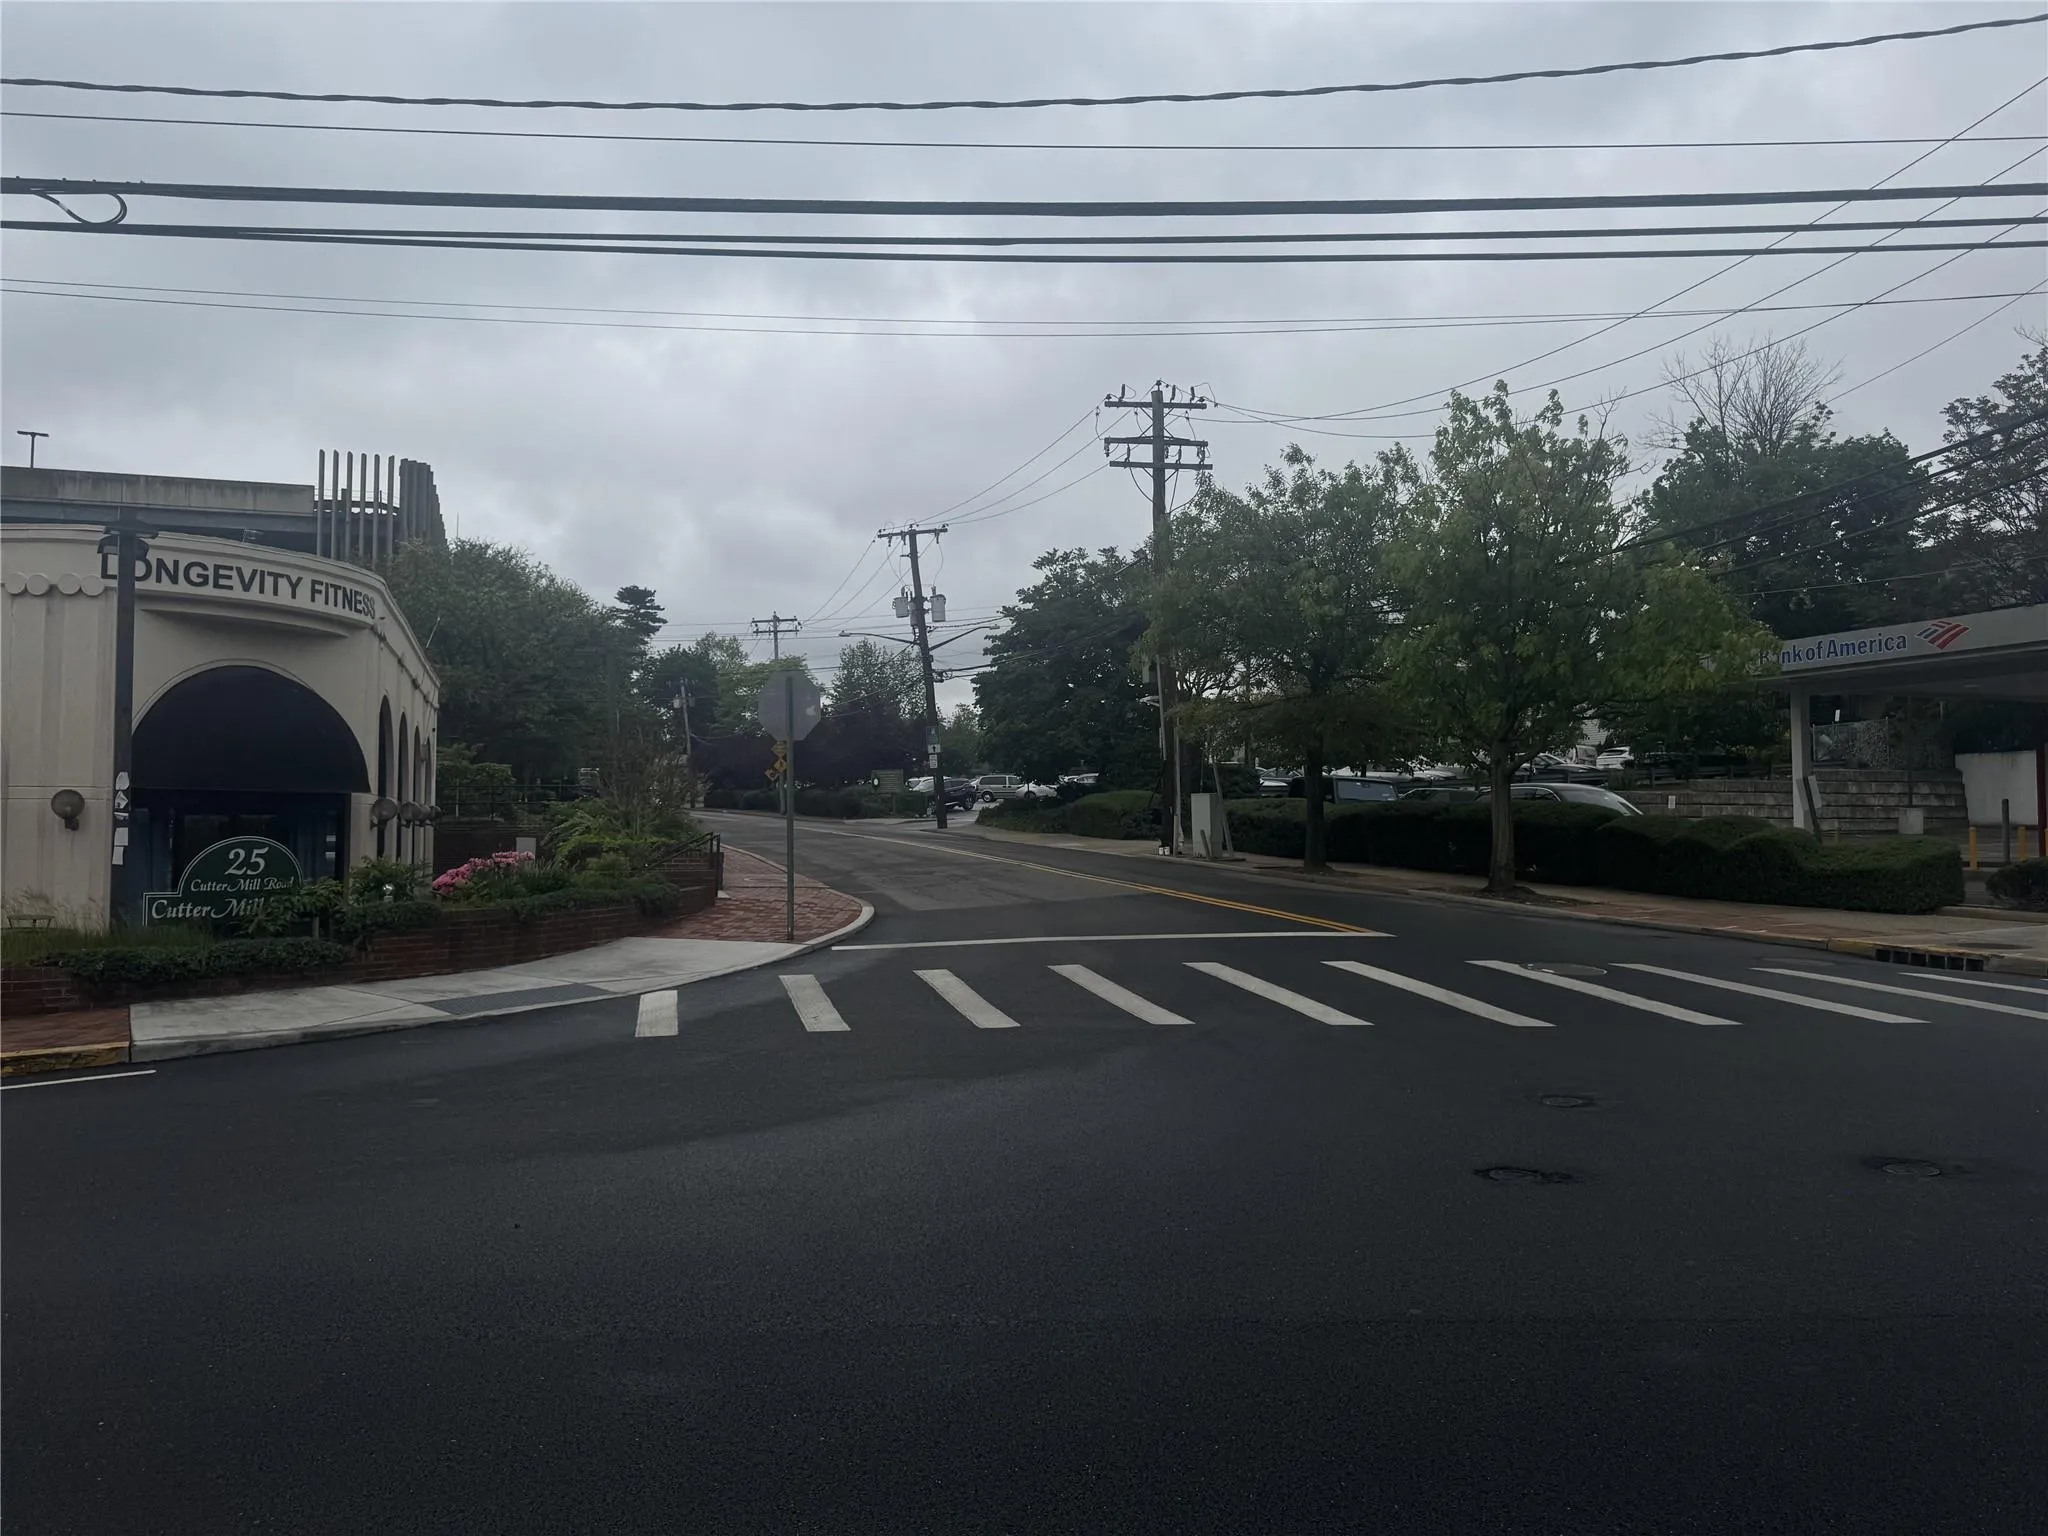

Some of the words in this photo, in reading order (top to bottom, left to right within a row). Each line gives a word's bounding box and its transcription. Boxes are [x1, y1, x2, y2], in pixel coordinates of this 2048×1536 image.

[310, 578, 376, 620] FITNESS
[1805, 640, 1823, 661] of
[1826, 632, 1907, 659] America
[224, 846, 270, 876] 25
[190, 879, 228, 892] Cutter
[227, 878, 262, 892] Mill
[151, 899, 212, 919] Cutter
